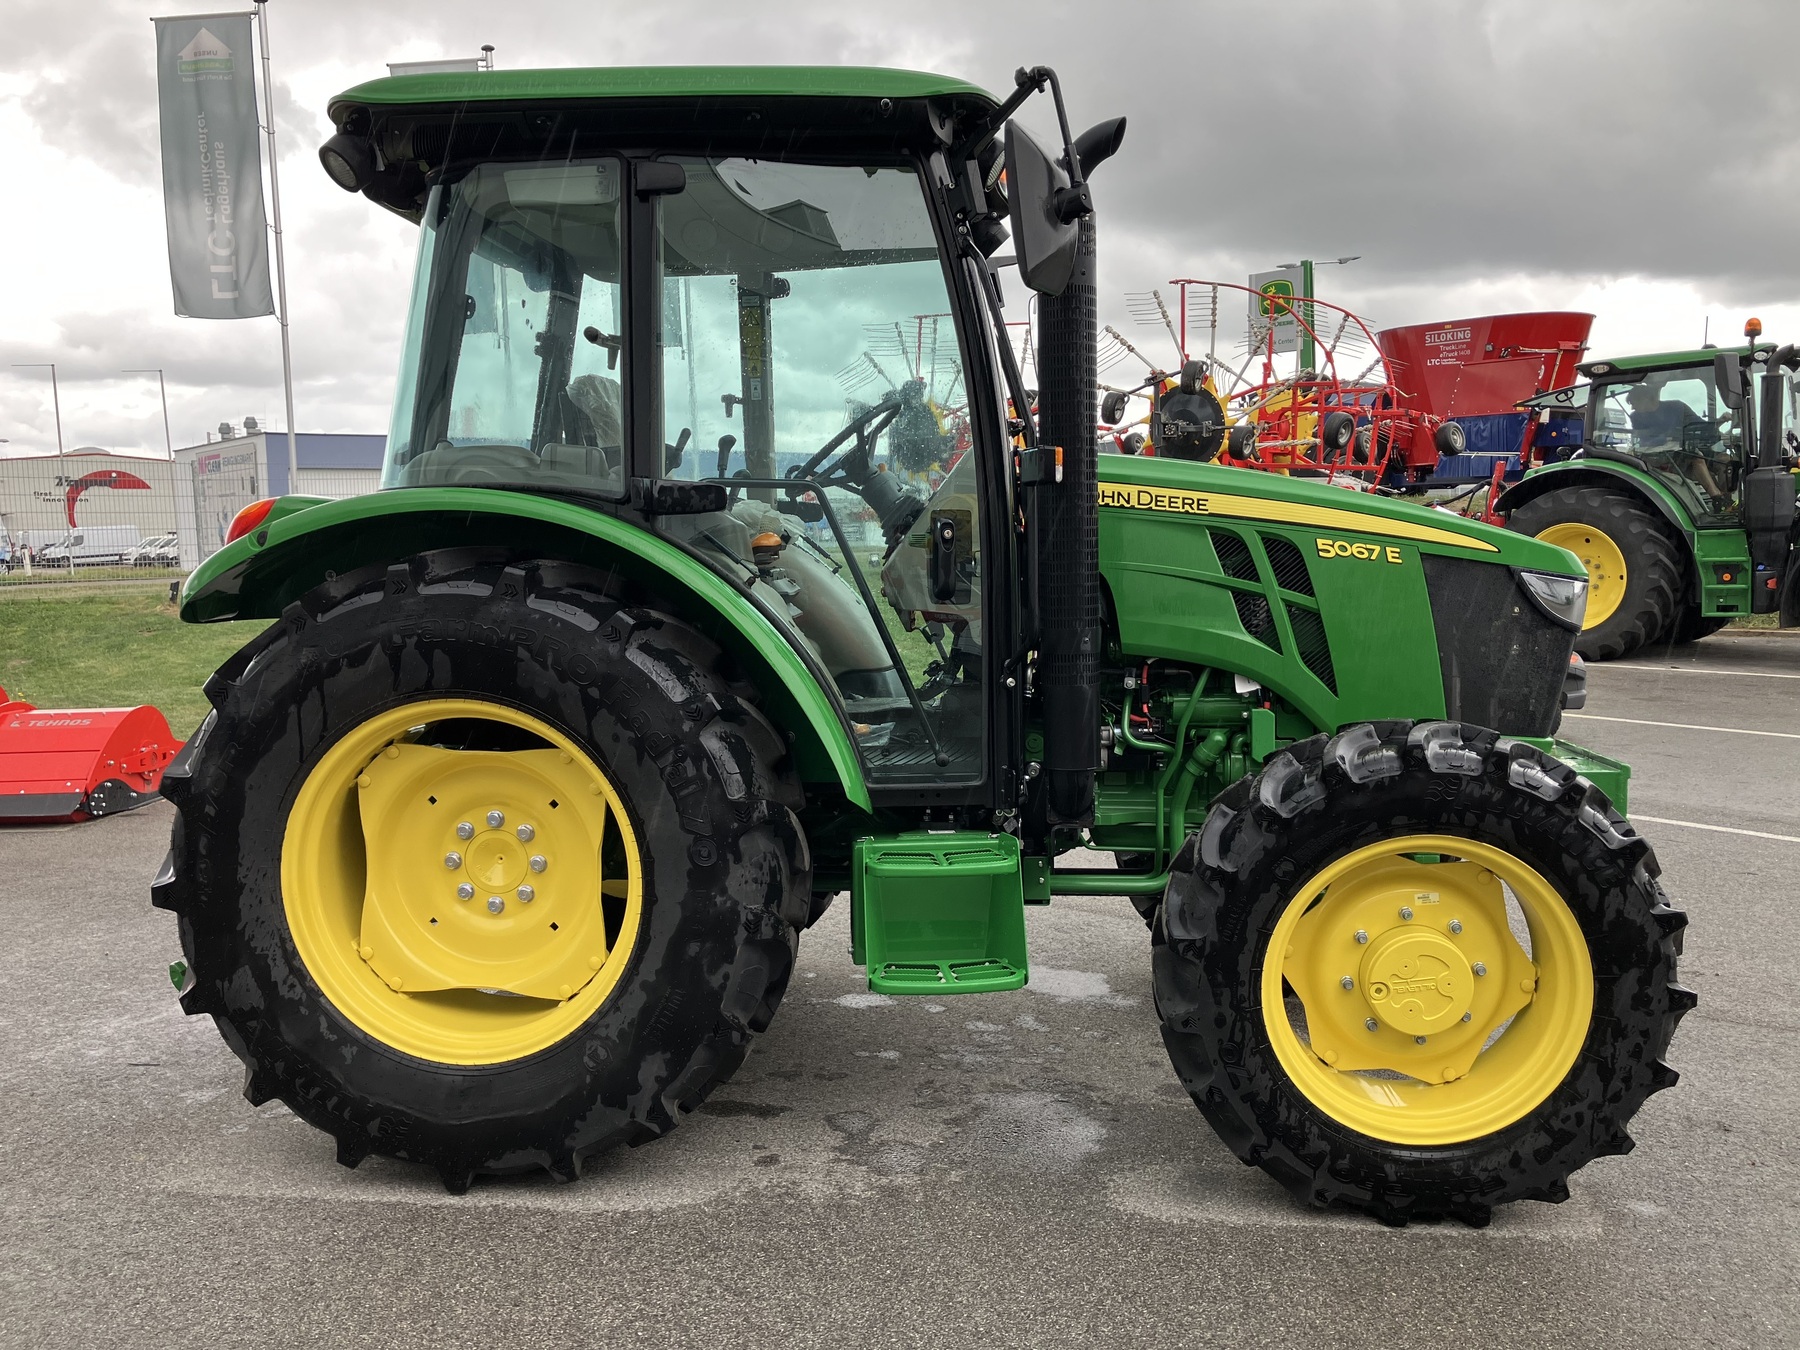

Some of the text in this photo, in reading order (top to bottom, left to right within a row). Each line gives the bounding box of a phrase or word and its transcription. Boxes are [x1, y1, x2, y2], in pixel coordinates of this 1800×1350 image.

[1425, 330, 1471, 343] SILOKING
[1427, 358, 1440, 366] LTC
[1097, 489, 1209, 512] HN DEERE
[1315, 538, 1403, 564] 5067 E
[28, 718, 93, 727] TEHNOS
